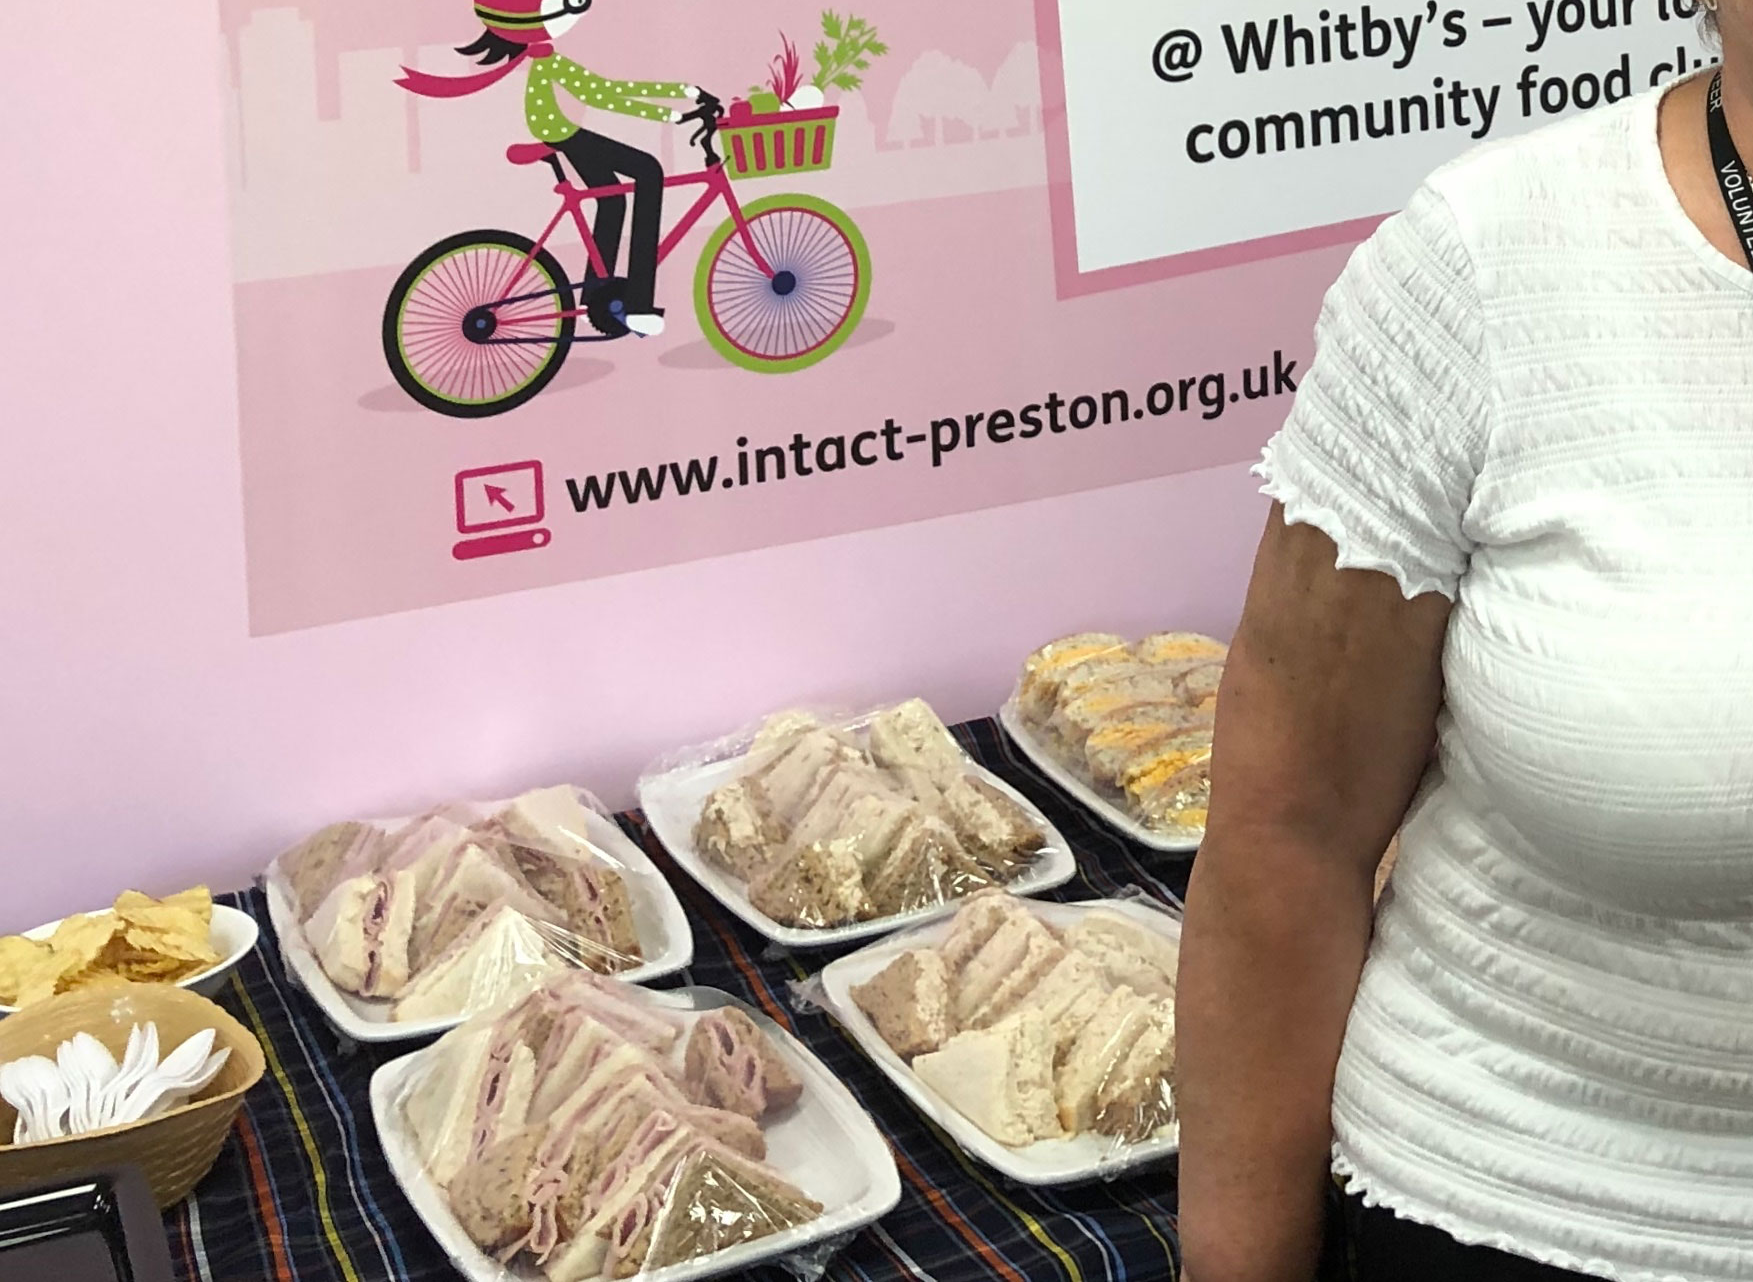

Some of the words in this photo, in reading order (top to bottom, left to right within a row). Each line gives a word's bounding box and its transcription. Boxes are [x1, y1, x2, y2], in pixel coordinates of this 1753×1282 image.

[1151, 29, 1202, 83] @
[1221, 0, 1467, 73] Whitby's
[1185, 78, 1500, 163] community
[1516, 54, 1632, 119] food
[565, 350, 1299, 513] www.intact-preston.org.uk
